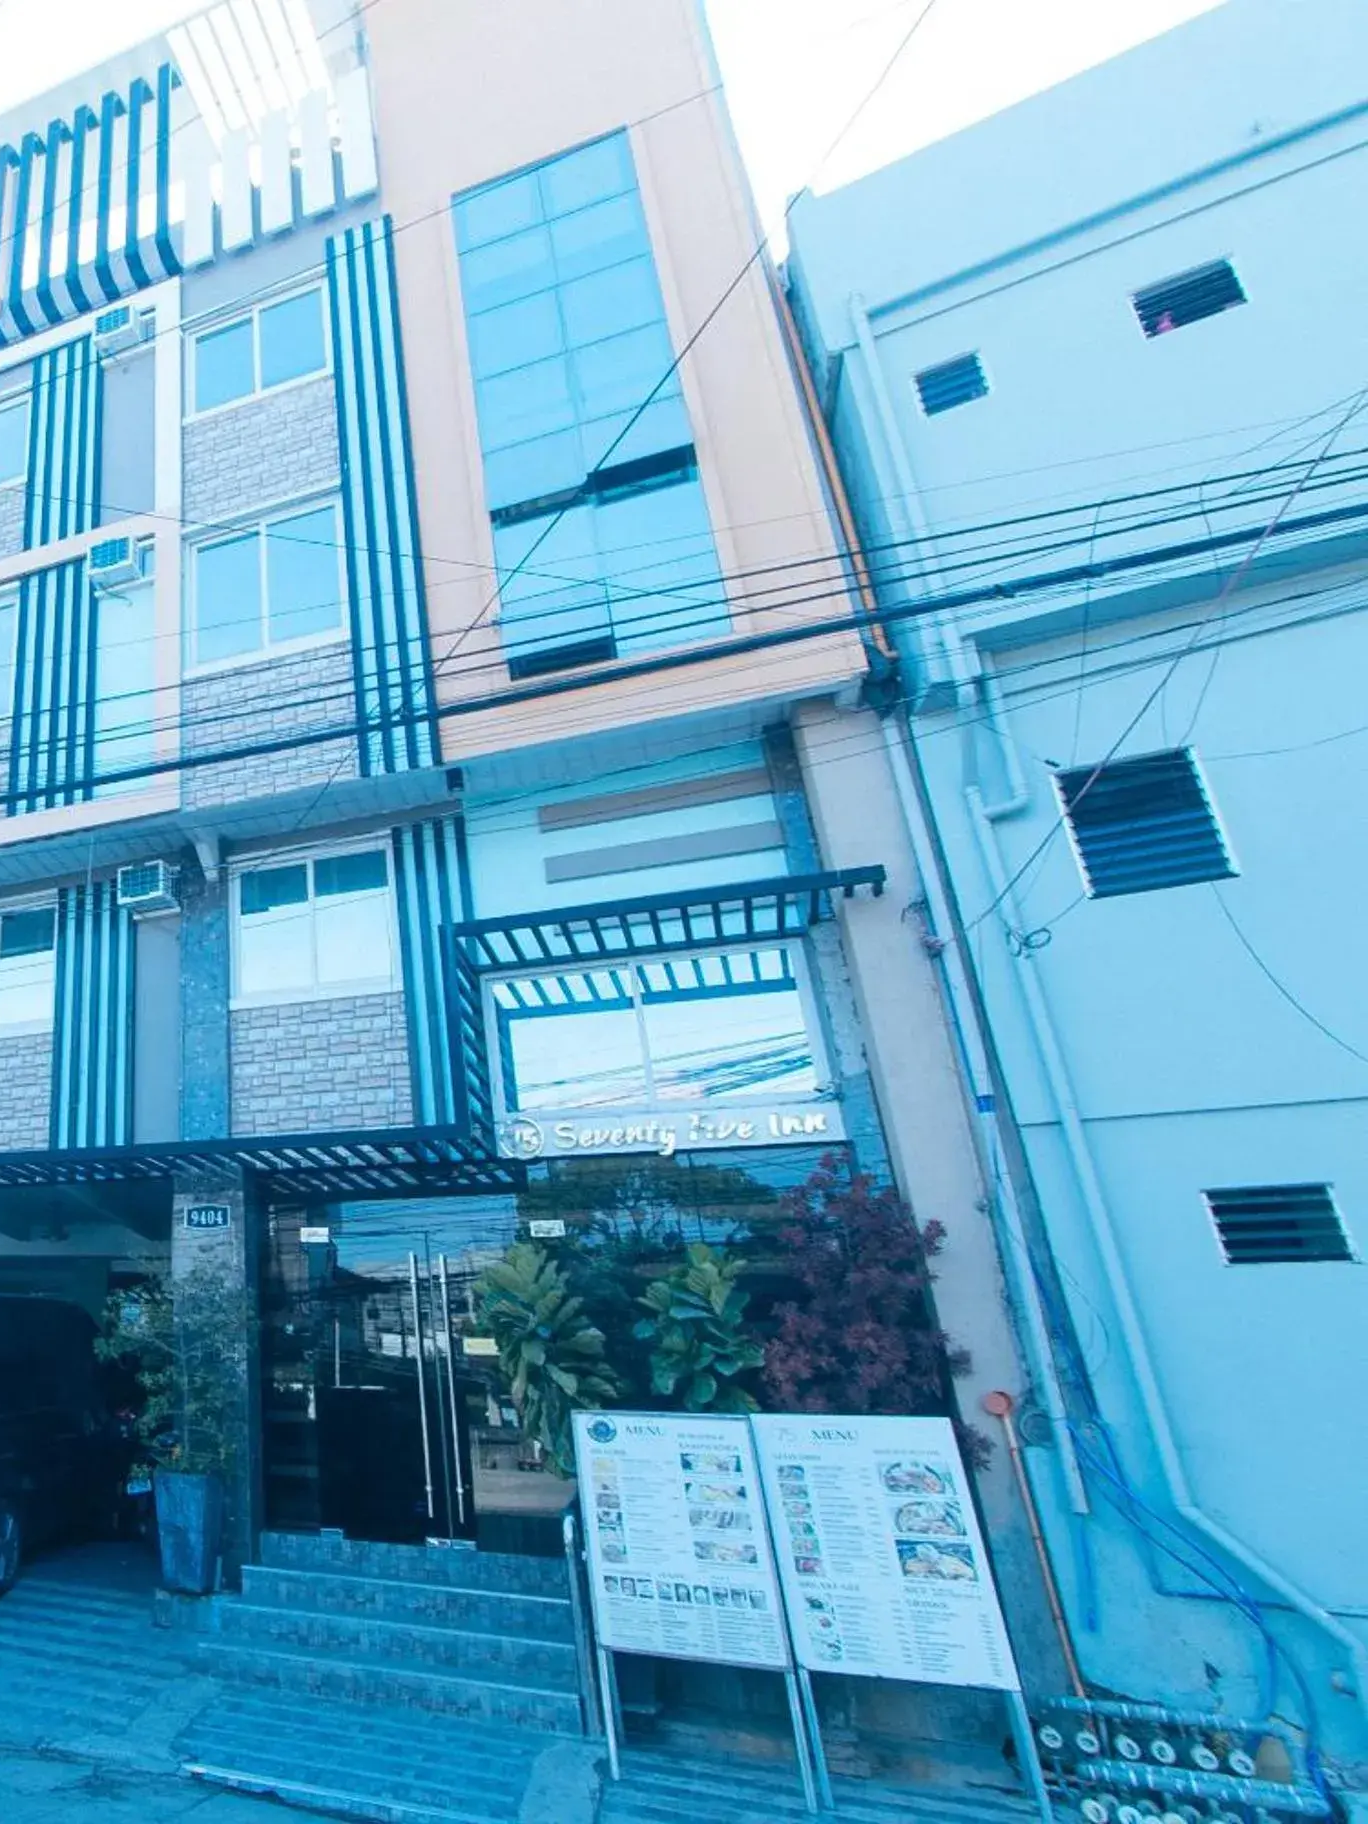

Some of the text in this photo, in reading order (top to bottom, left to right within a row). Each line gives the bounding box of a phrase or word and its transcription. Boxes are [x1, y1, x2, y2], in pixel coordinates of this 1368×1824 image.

[554, 1120, 676, 1156] Seventy
[688, 1112, 755, 1141] Five
[768, 1112, 827, 1138] Inn
[190, 1210, 224, 1225] 9404
[810, 1428, 859, 1441] MENU
